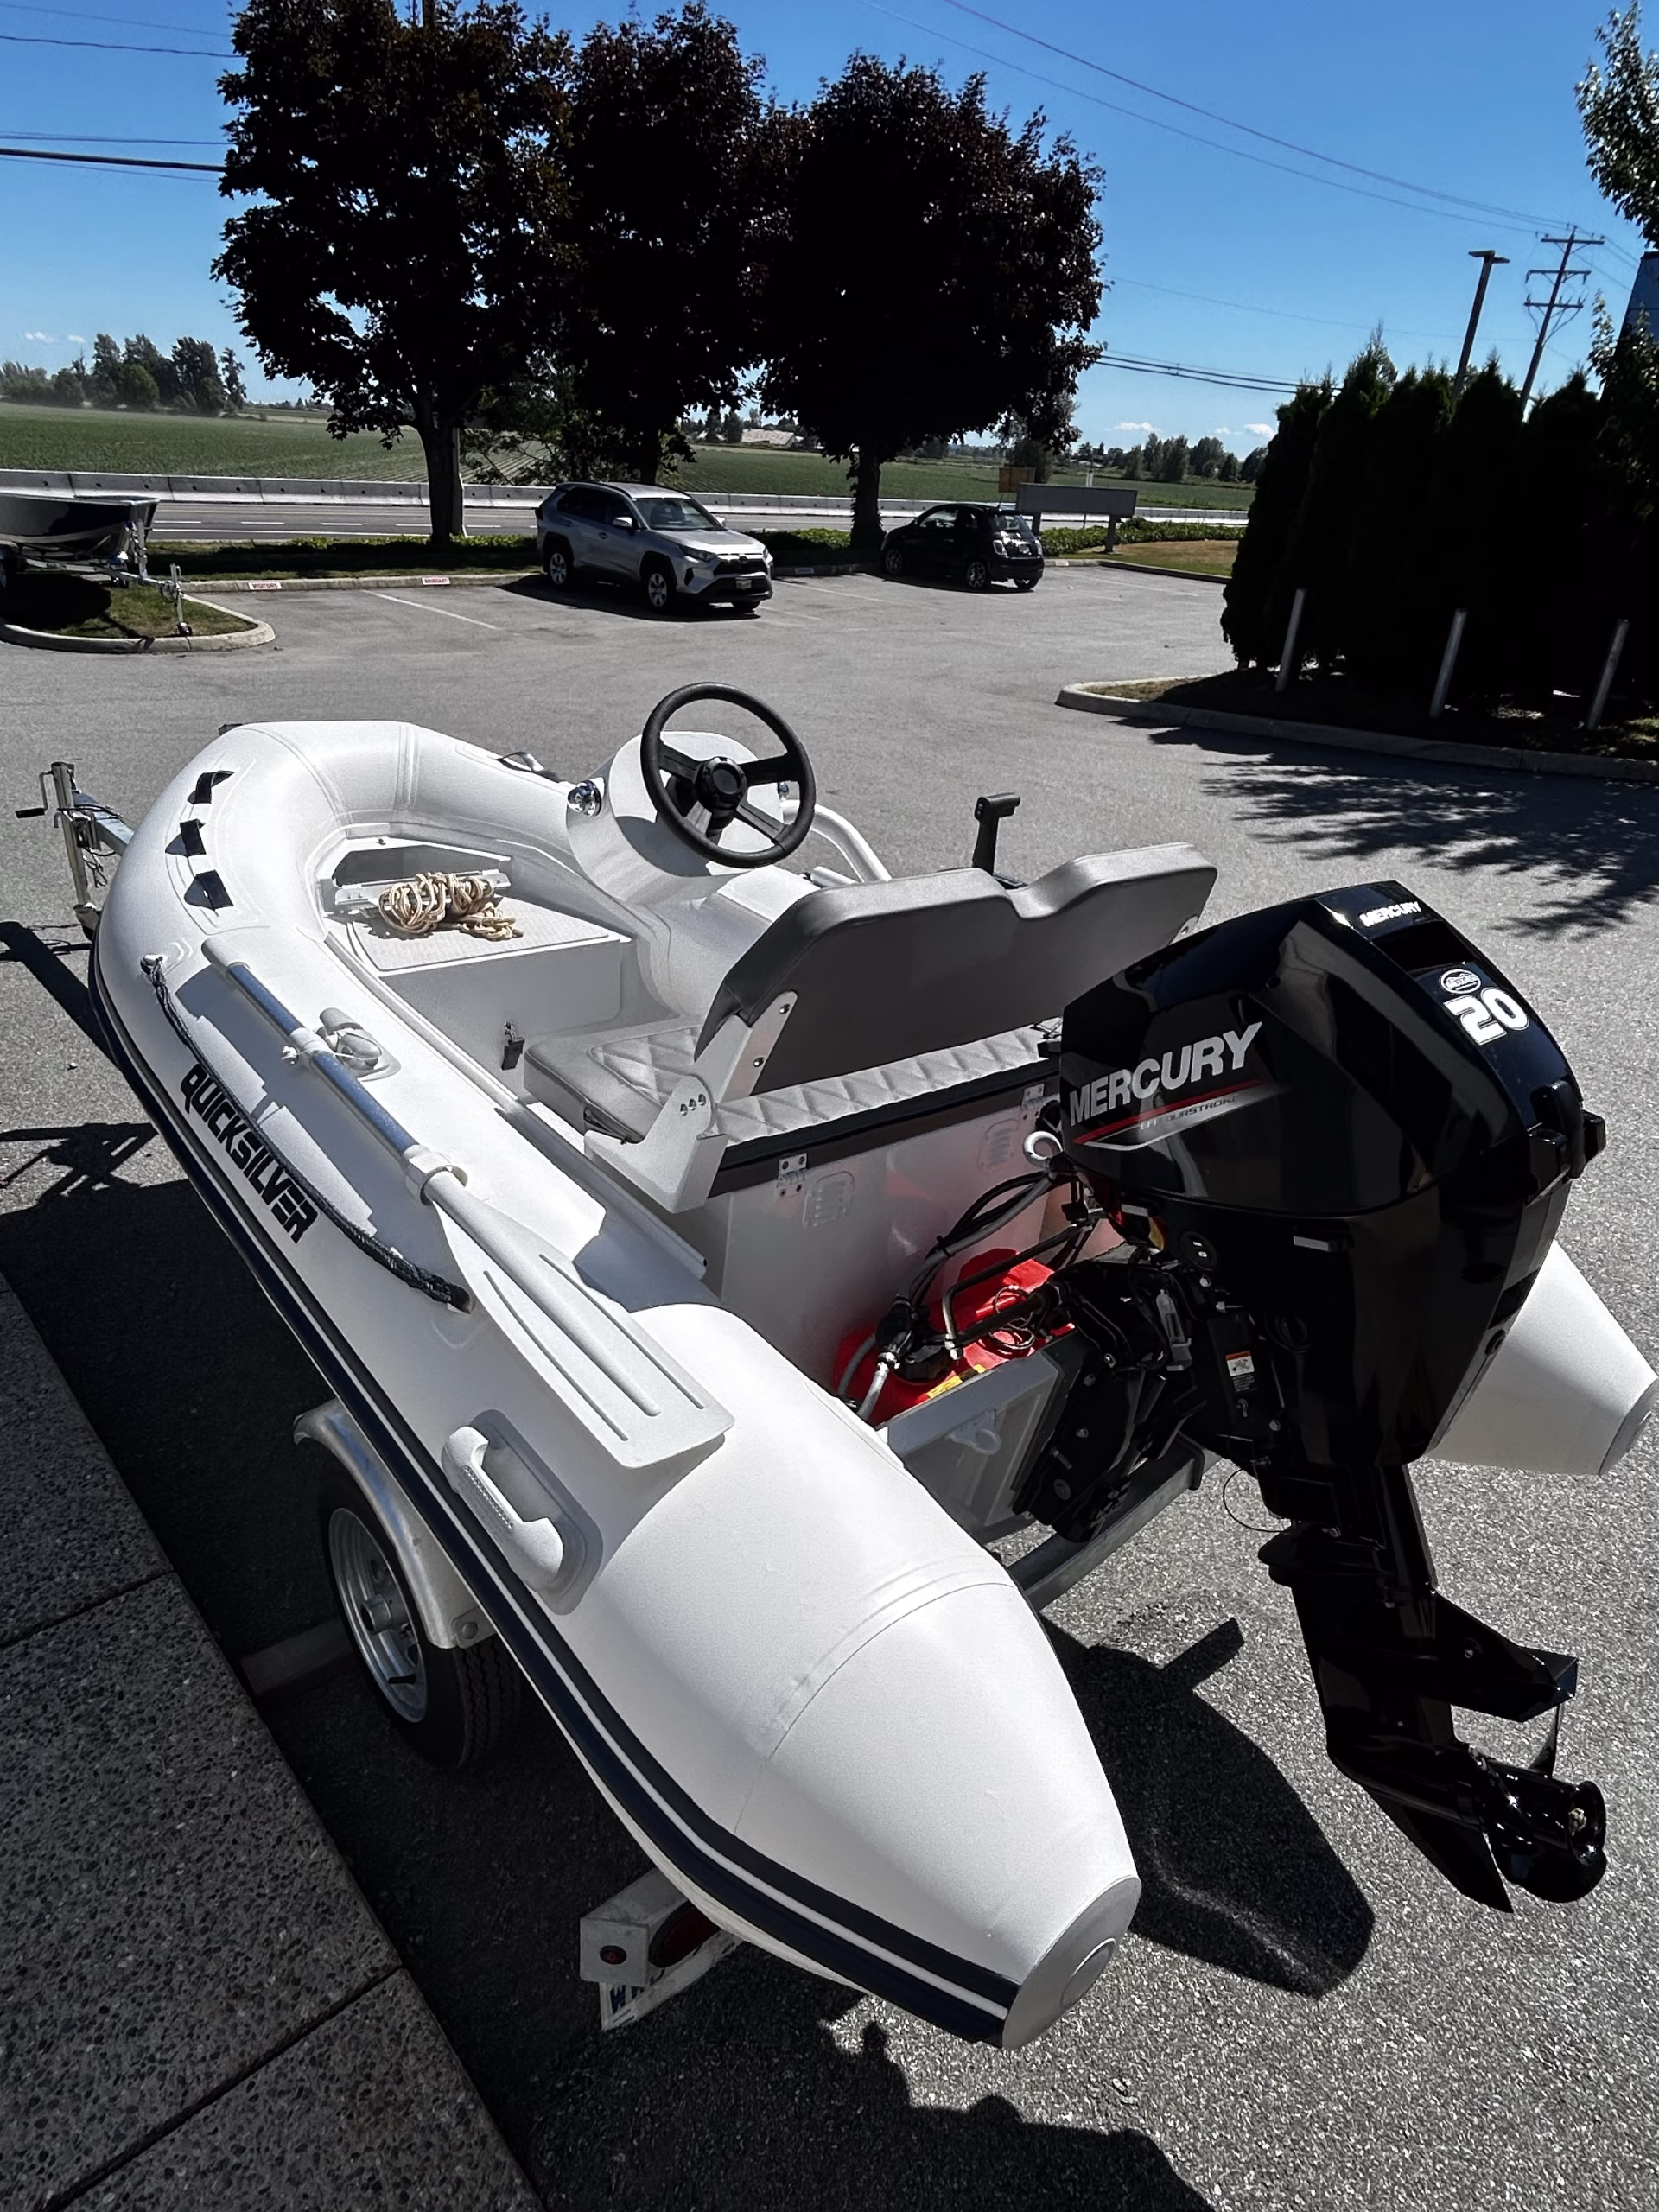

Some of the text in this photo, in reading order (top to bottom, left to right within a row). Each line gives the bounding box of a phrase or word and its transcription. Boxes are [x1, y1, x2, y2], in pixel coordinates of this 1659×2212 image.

[1359, 901, 1421, 926] MERCURY
[1443, 986, 1529, 1046] 20
[1070, 1021, 1262, 1126] MERCURY
[181, 1064, 318, 1243] QUICKSILVER
